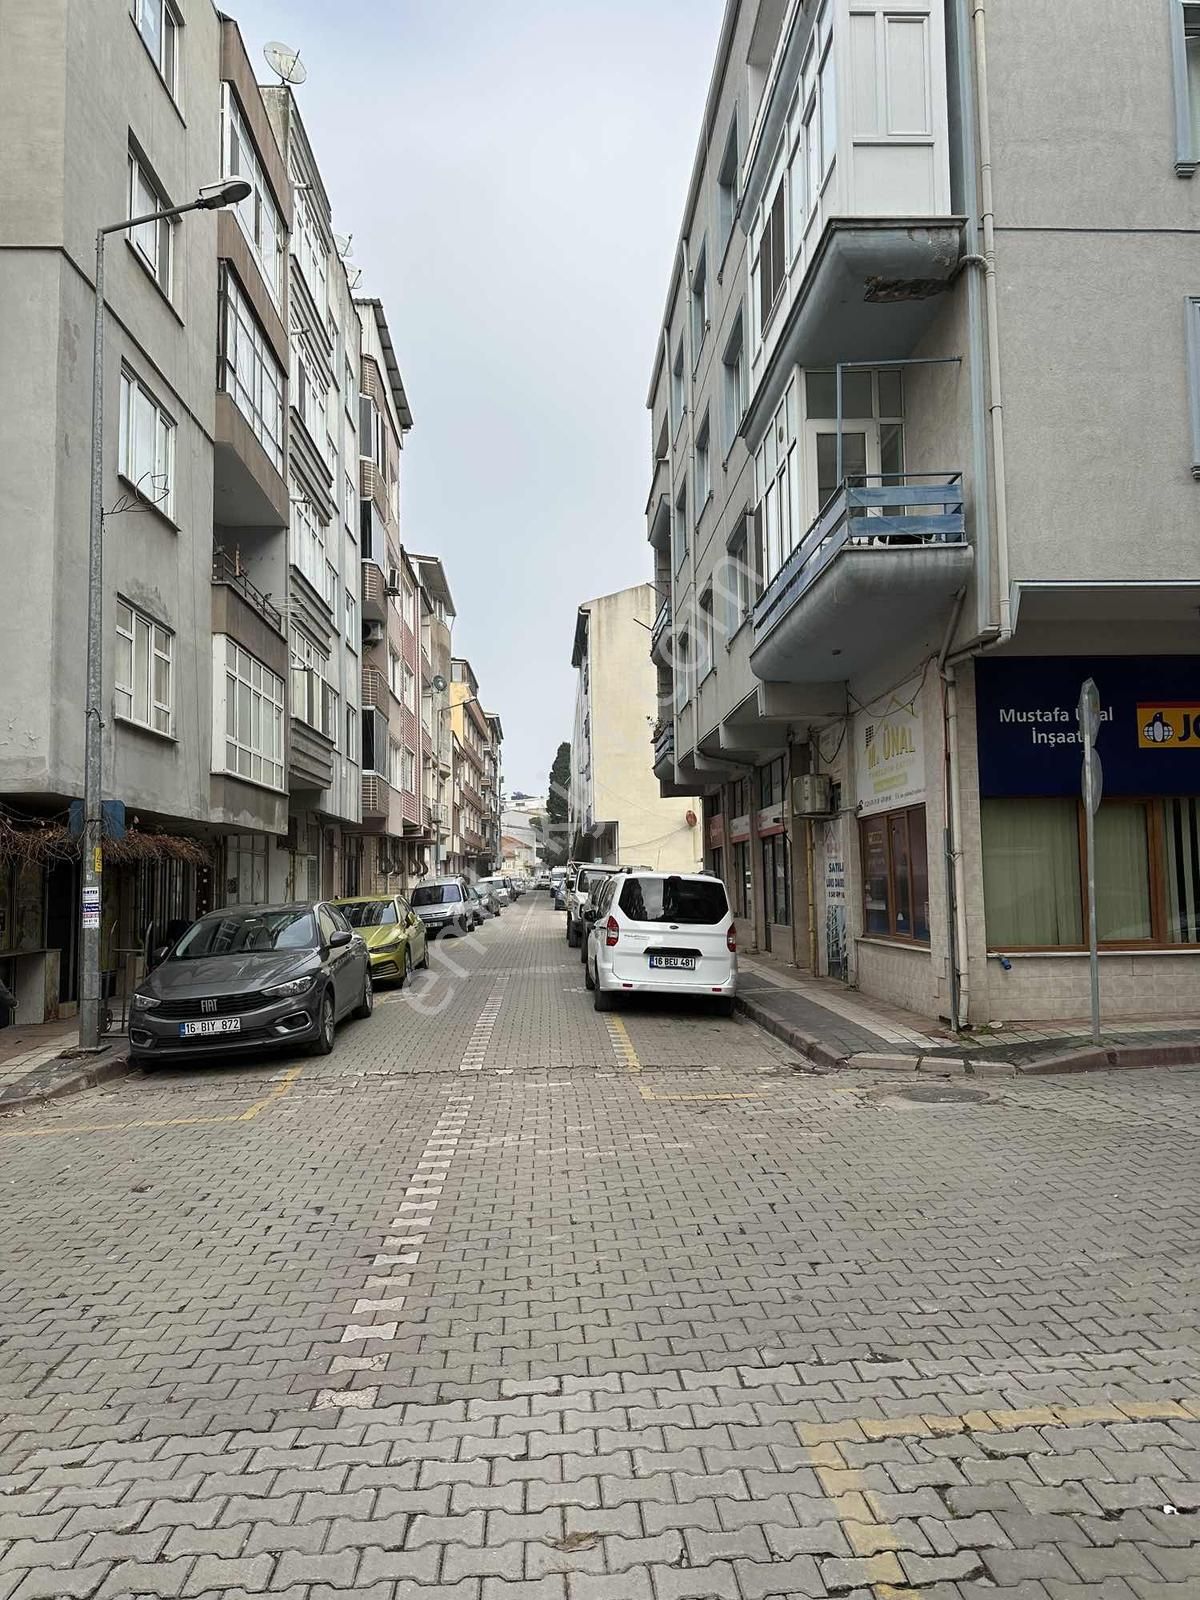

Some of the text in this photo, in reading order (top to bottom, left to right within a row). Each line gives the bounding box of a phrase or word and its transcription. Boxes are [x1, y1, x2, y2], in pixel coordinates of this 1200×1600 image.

[1000, 707, 1069, 723] Mustafa
[1032, 728, 1084, 747] İnşaat
[655, 957, 693, 967] 16 BEU 481
[201, 999, 217, 1012] FIAT
[186, 1019, 239, 1033] 16 BIY 872
